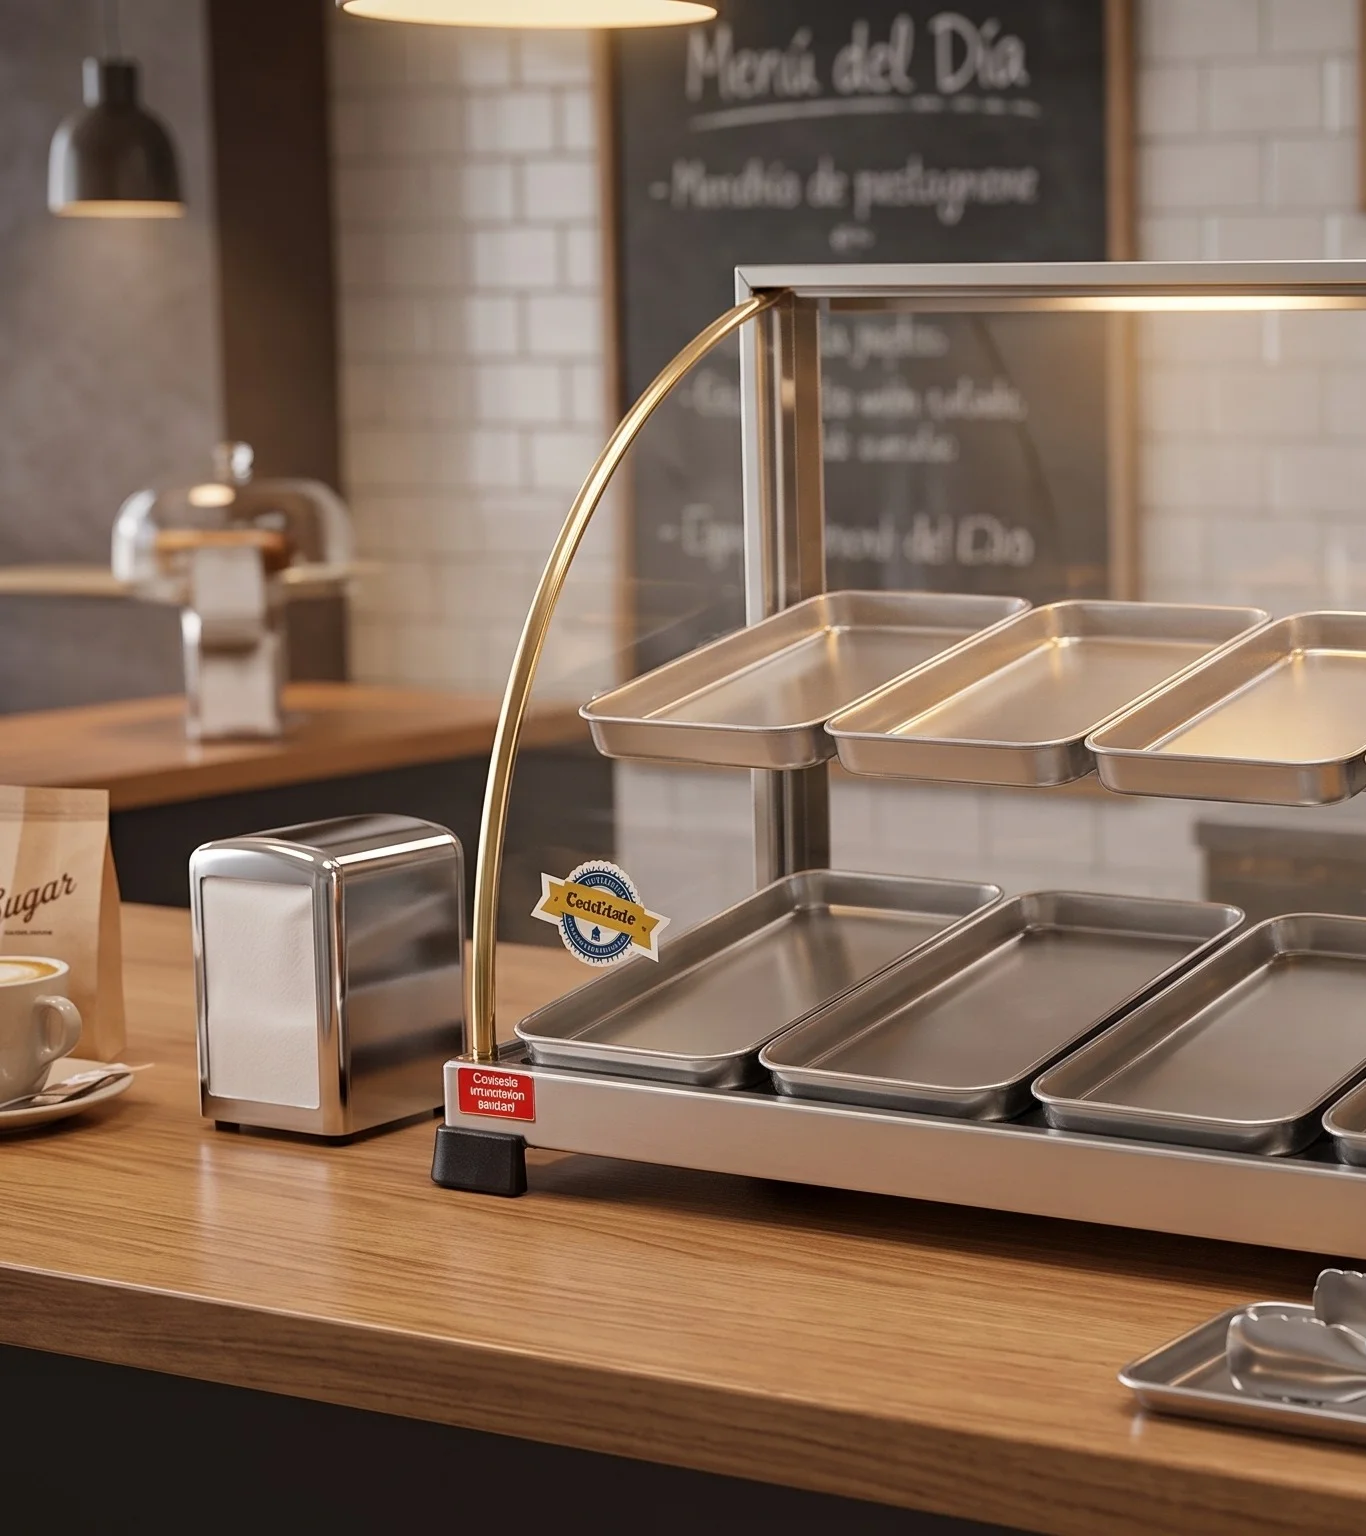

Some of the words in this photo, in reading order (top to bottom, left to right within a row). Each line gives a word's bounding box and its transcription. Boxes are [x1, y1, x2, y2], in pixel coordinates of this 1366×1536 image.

[686, 23, 821, 99] Menú
[833, 14, 915, 95] del
[928, 10, 1030, 94] Día
[807, 153, 848, 208] de
[0, 872, 77, 923] ugar
